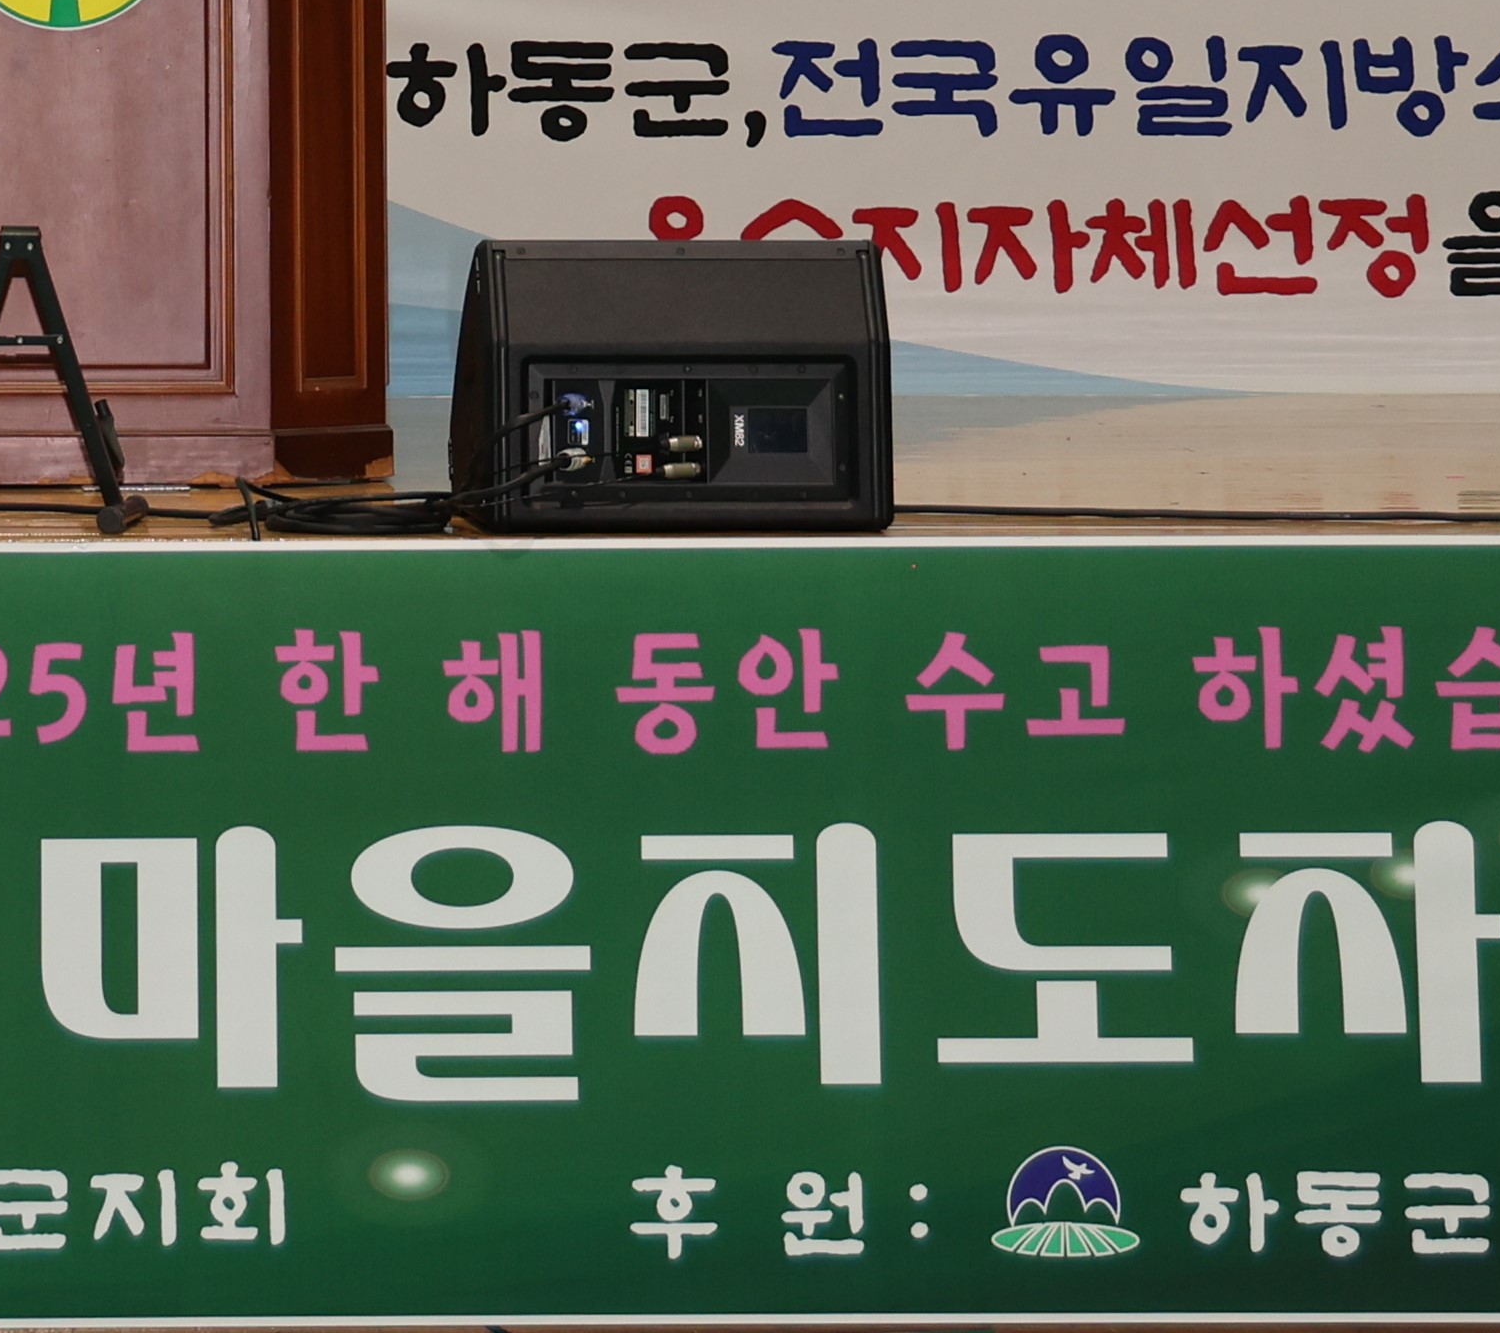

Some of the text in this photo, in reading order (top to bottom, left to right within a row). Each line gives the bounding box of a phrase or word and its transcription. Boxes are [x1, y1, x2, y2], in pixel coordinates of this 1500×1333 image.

[734, 414, 745, 447] XM82
[275, 629, 380, 751] 한
[443, 630, 543, 753] 해
[616, 628, 839, 754] 동안
[906, 632, 1126, 751] 수고
[629, 1164, 719, 1261] 후
[1180, 1170, 1492, 1259] 하동군
